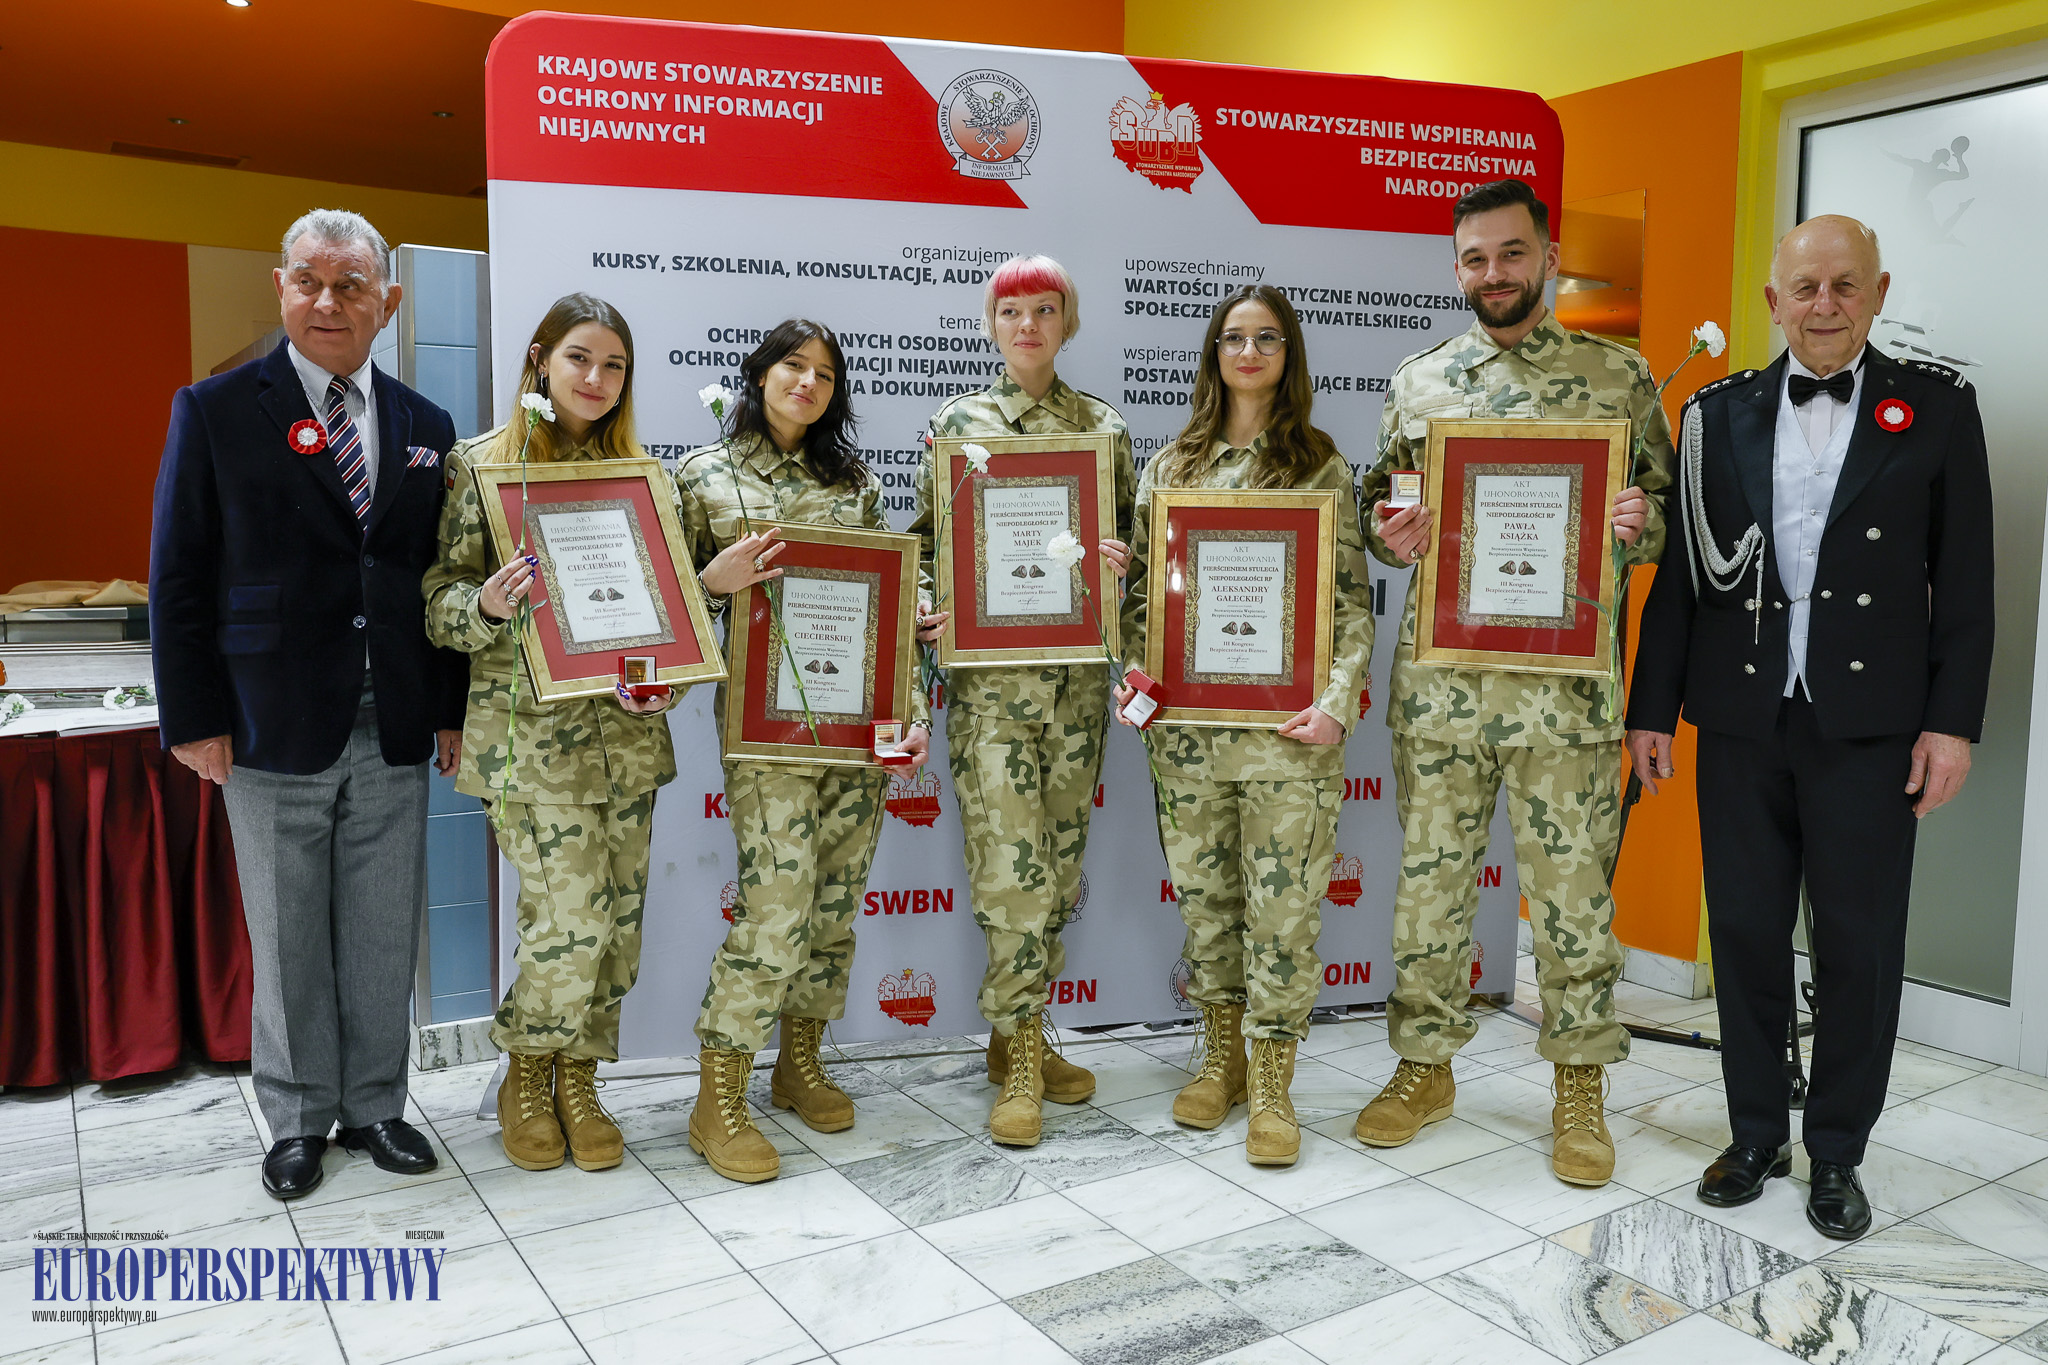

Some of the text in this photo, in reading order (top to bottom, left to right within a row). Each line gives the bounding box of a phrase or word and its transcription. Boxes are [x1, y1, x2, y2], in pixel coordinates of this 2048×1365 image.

[538, 55, 883, 95] KRAJOWE STOWARZYSZENIE
[953, 73, 1024, 96] STOWARZYSZENIE
[538, 86, 824, 126] OCHRONY INFORMACJI
[539, 116, 706, 146] NIEJAWNYCH
[940, 104, 1038, 152] KRAJOWE OCHRONY
[1216, 108, 1537, 150] STOWARZYSZENIE WSPIERANIA
[972, 162, 1014, 171] INFORMACJI
[1360, 147, 1537, 176] BEZPIECZEŃSTWA
[970, 170, 1014, 178] NIEJAWNYCH
[1385, 176, 1484, 198] NARODO
[592, 252, 996, 286] KURSY, SZKOLENIA, KONSULTACJE, AUDY
[1125, 258, 1266, 282] upowszechniamy
[1124, 278, 1218, 298] WARTOŚCI
[1357, 290, 1472, 312] NOWOCZESNE
[938, 314, 981, 330] tema
[1124, 300, 1432, 330] SPOŁECZE BYWATELSKIEGO
[898, 334, 1001, 354] OSOBOWY
[1124, 346, 1202, 364] wspieram
[668, 350, 752, 367] OCHRO
[898, 358, 1006, 378] NIEJAWNYC
[1124, 367, 1198, 384] POSTAW
[1484, 490, 1560, 498] UHONOROWANIA
[992, 500, 1061, 509] UHONOROWANIA
[550, 523, 622, 534] UHONOROWANIA
[1500, 530, 1539, 542] KSIĄŻKA
[550, 534, 596, 544] PIERŚCIENIEM
[559, 542, 614, 552] NIEPODLEGŁOŚCI
[1014, 539, 1042, 547] MAJEK
[581, 553, 608, 562] ALICJI
[567, 561, 627, 572] CIECIERSKIEJ
[791, 592, 860, 603] UHONOROWANIA
[1216, 595, 1264, 604] GAŁECKIEJ
[787, 602, 863, 613] PIERŚCIENIEM STULECIA
[793, 612, 847, 621] NIEPODLEGŁOŚCI
[811, 624, 837, 632] MARII
[794, 632, 852, 644] CIECIERSKIEJ
[864, 888, 954, 916] SWBN
[1324, 962, 1372, 986] OIN
